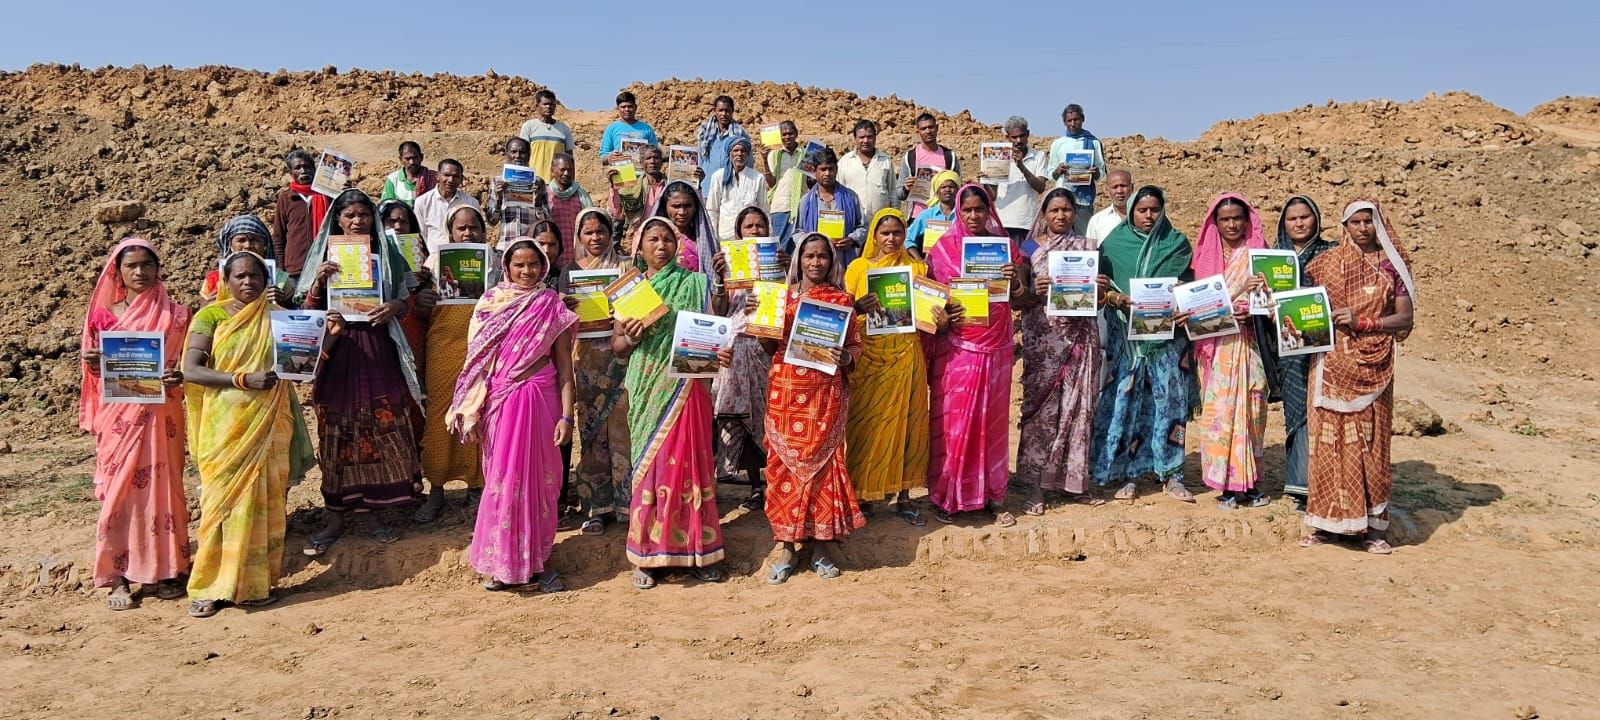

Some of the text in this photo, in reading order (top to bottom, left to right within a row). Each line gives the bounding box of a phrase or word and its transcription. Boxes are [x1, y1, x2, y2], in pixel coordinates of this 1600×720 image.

[1272, 264, 1292, 275] 125 दिन
[1300, 304, 1322, 316] 125 दिन
